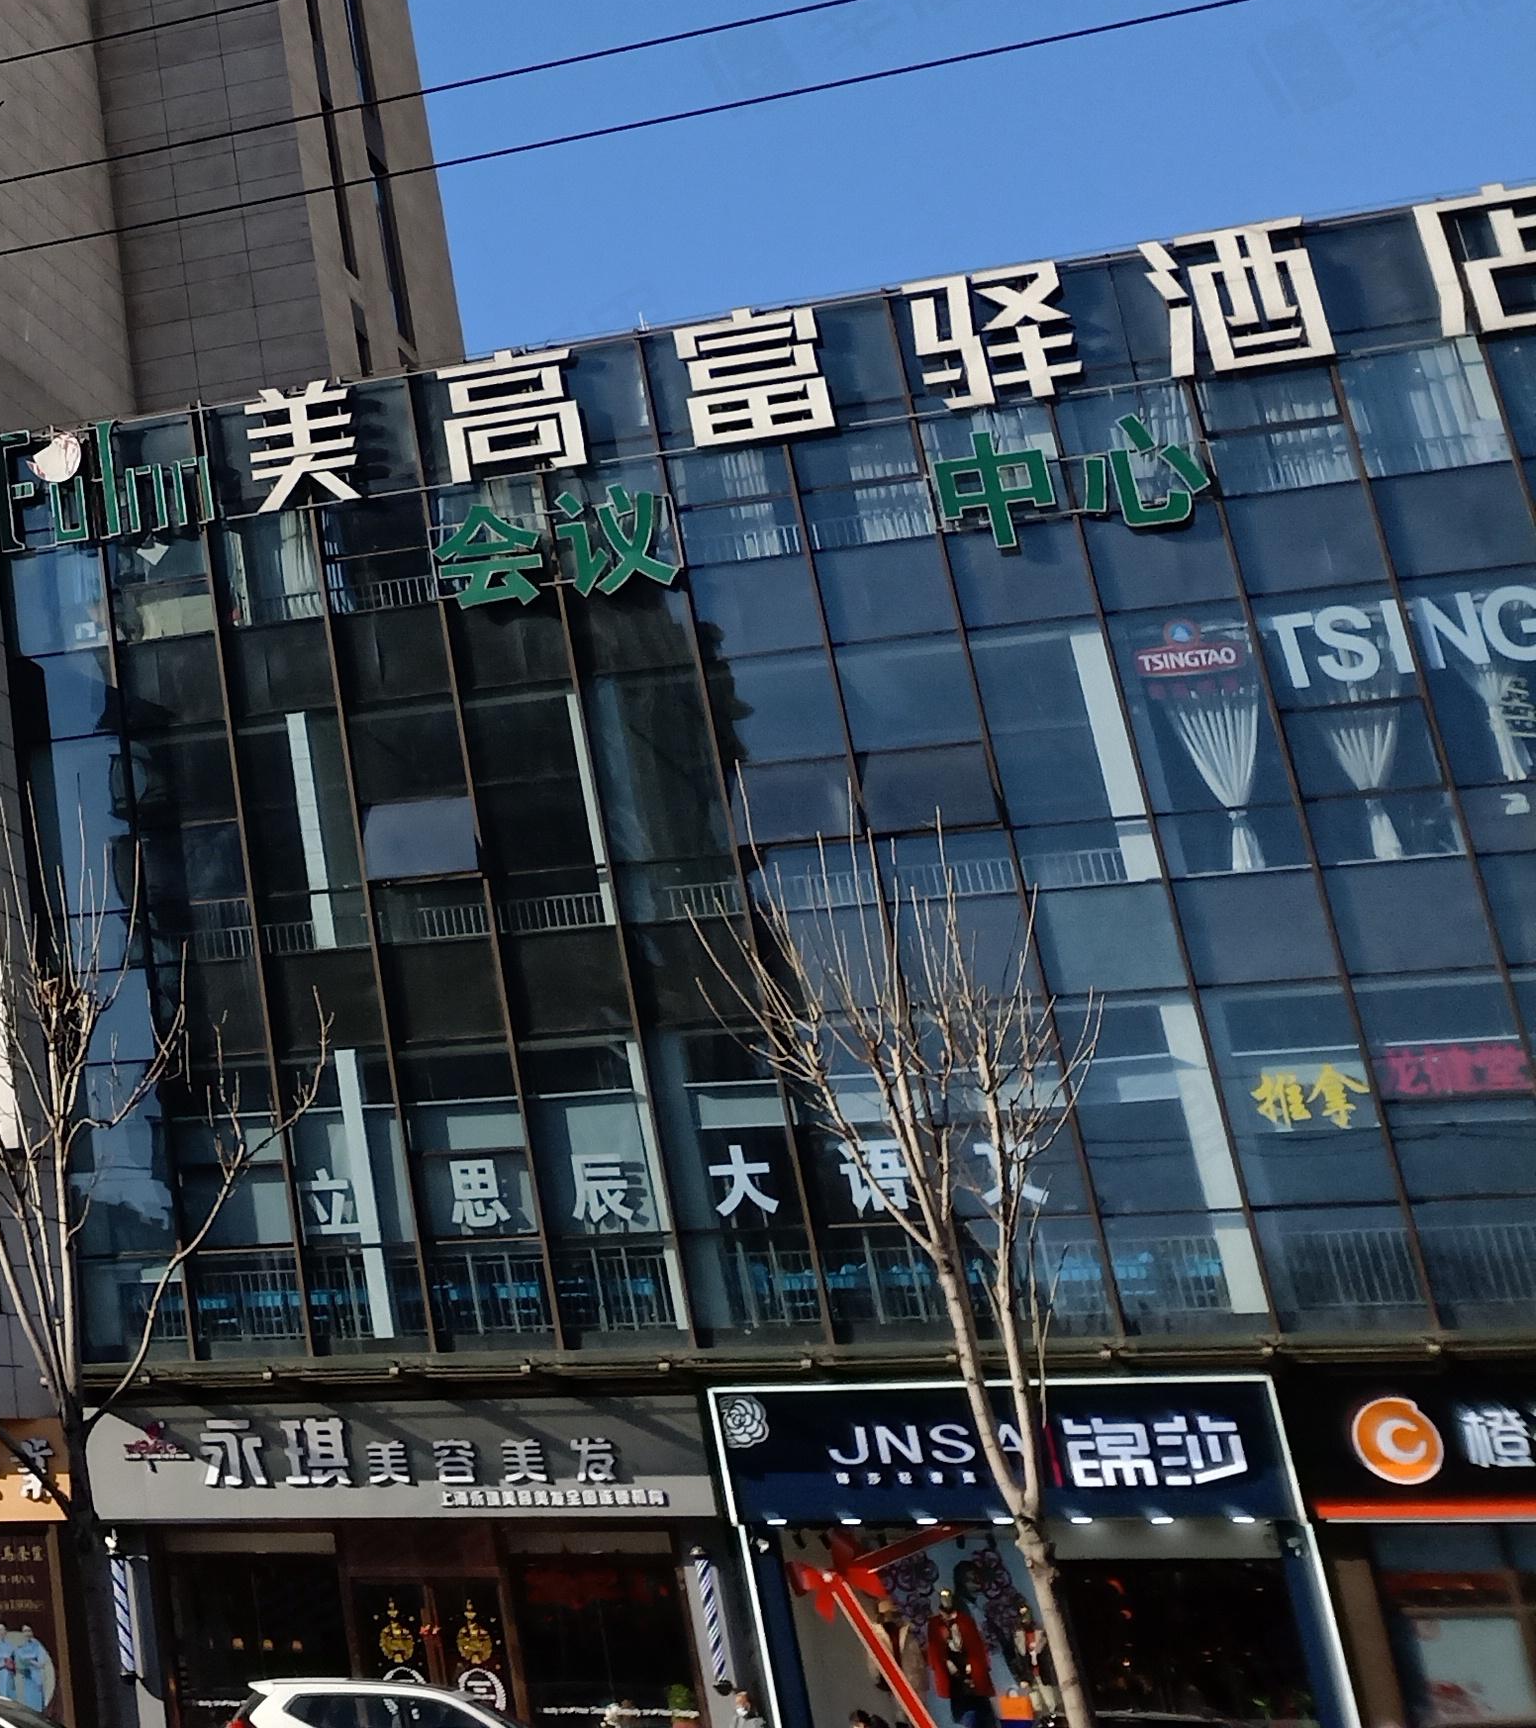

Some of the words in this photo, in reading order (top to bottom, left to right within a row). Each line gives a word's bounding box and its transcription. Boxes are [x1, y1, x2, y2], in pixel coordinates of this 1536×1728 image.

[244, 184, 1535, 515] 美高富驿酒店
[433, 485, 680, 609] 会议
[931, 413, 1212, 549] 中心
[1138, 645, 1238, 673] TSINGTAO
[1249, 1064, 1371, 1129] 推拿
[199, 1417, 617, 1487] 永琪美容美发
[828, 1423, 1025, 1465] JNSA
